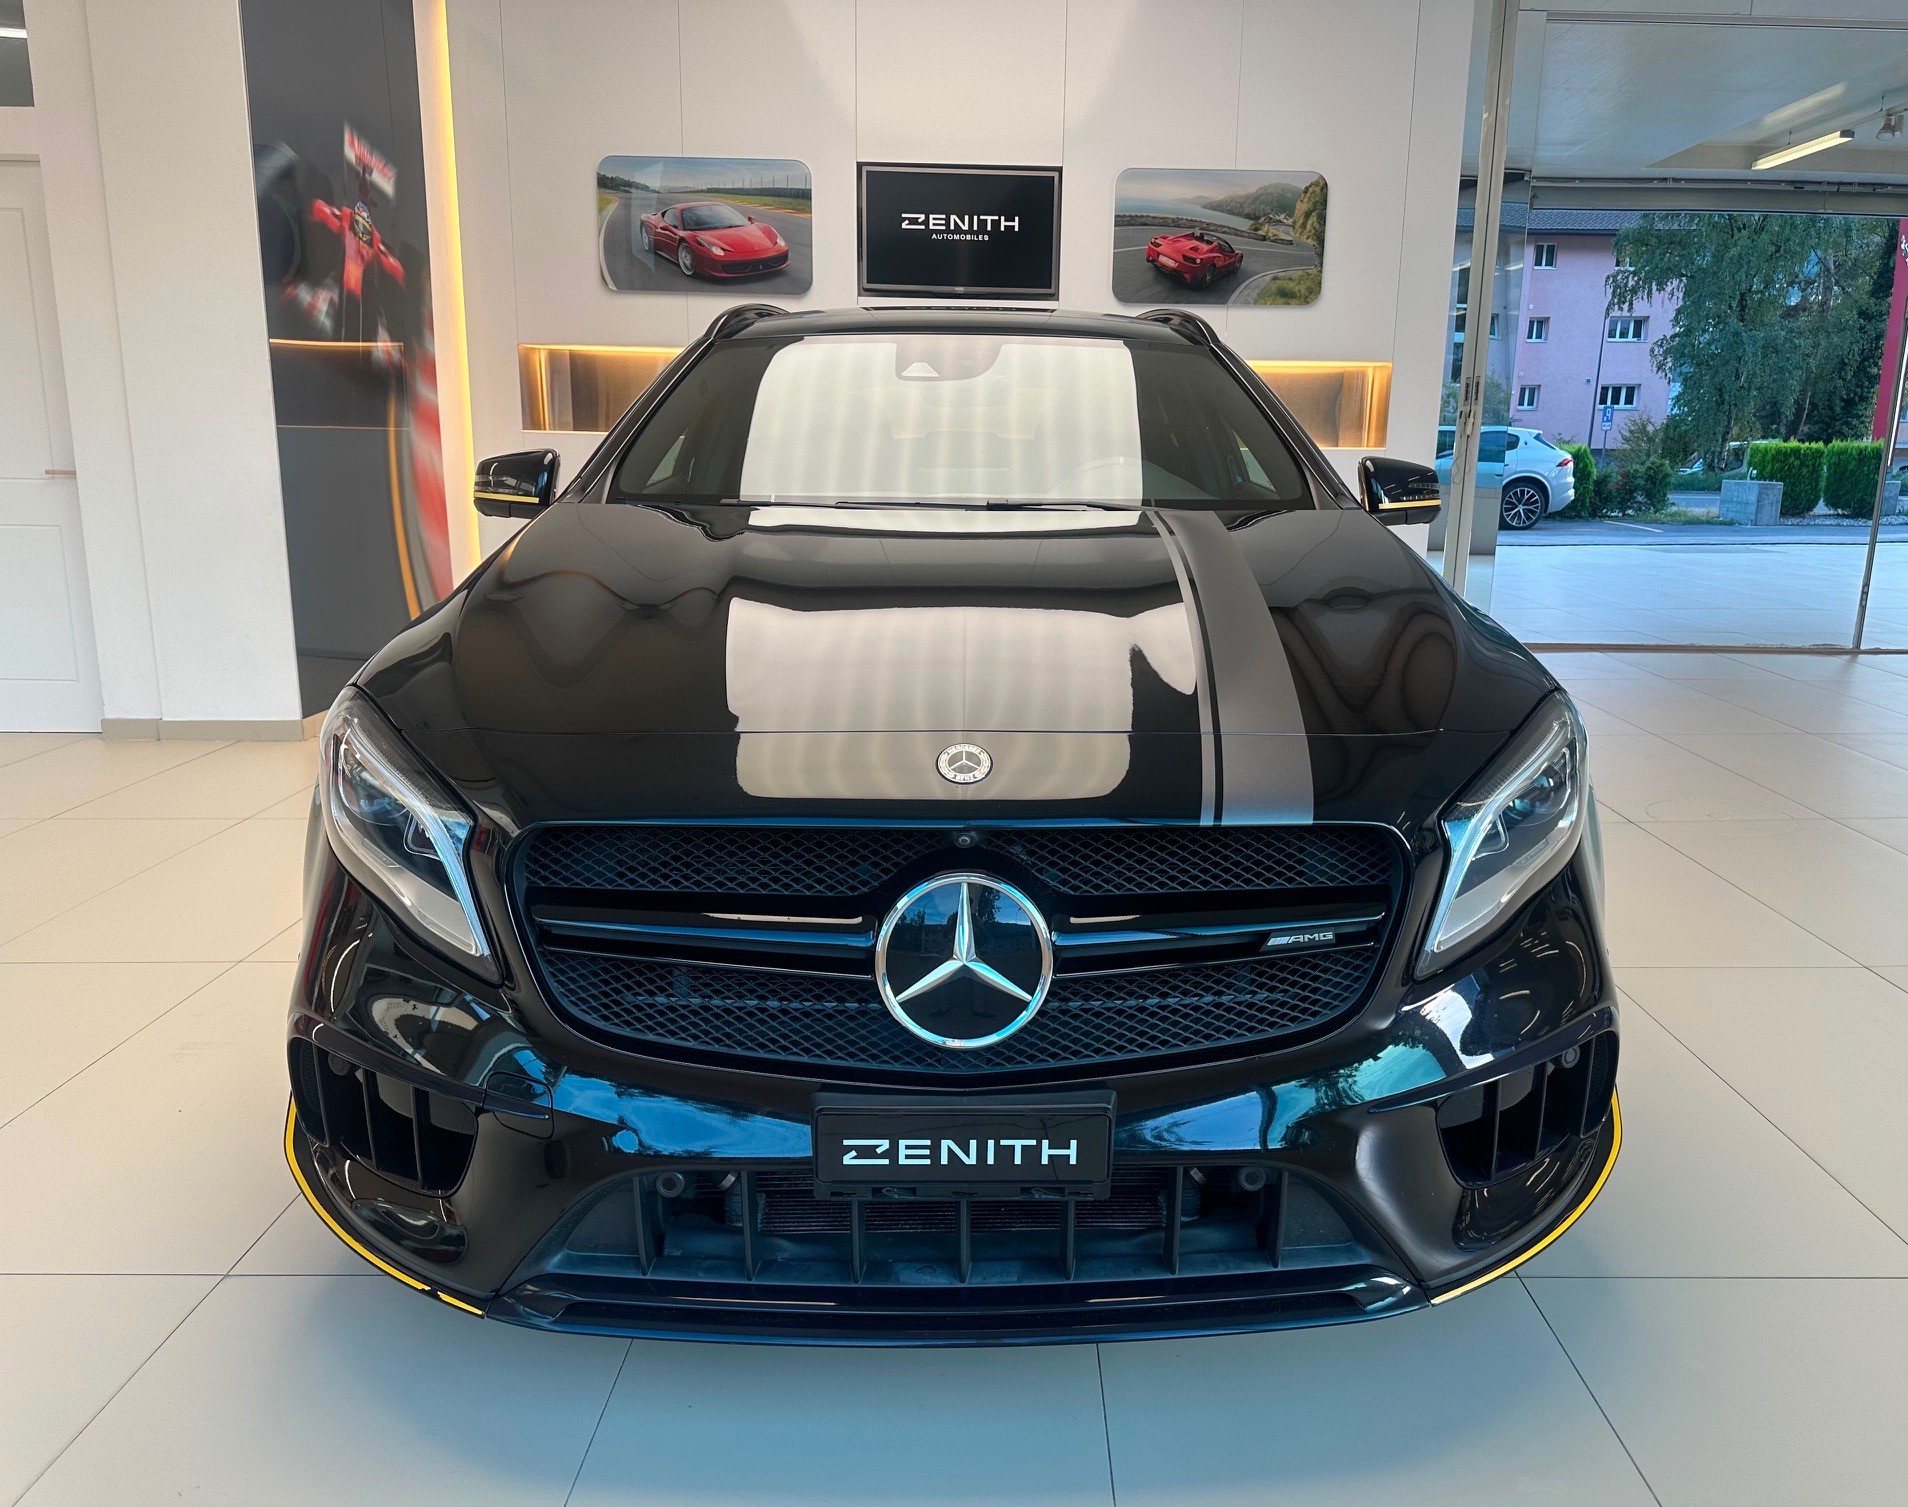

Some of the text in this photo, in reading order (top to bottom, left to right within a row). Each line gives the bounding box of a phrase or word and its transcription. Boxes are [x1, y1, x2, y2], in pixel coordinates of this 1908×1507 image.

[901, 213, 1019, 232] ZENITH
[931, 233, 989, 241] AUTOMOBILES
[1288, 931, 1334, 944] AMG
[842, 1139, 1078, 1165] ZENITH
